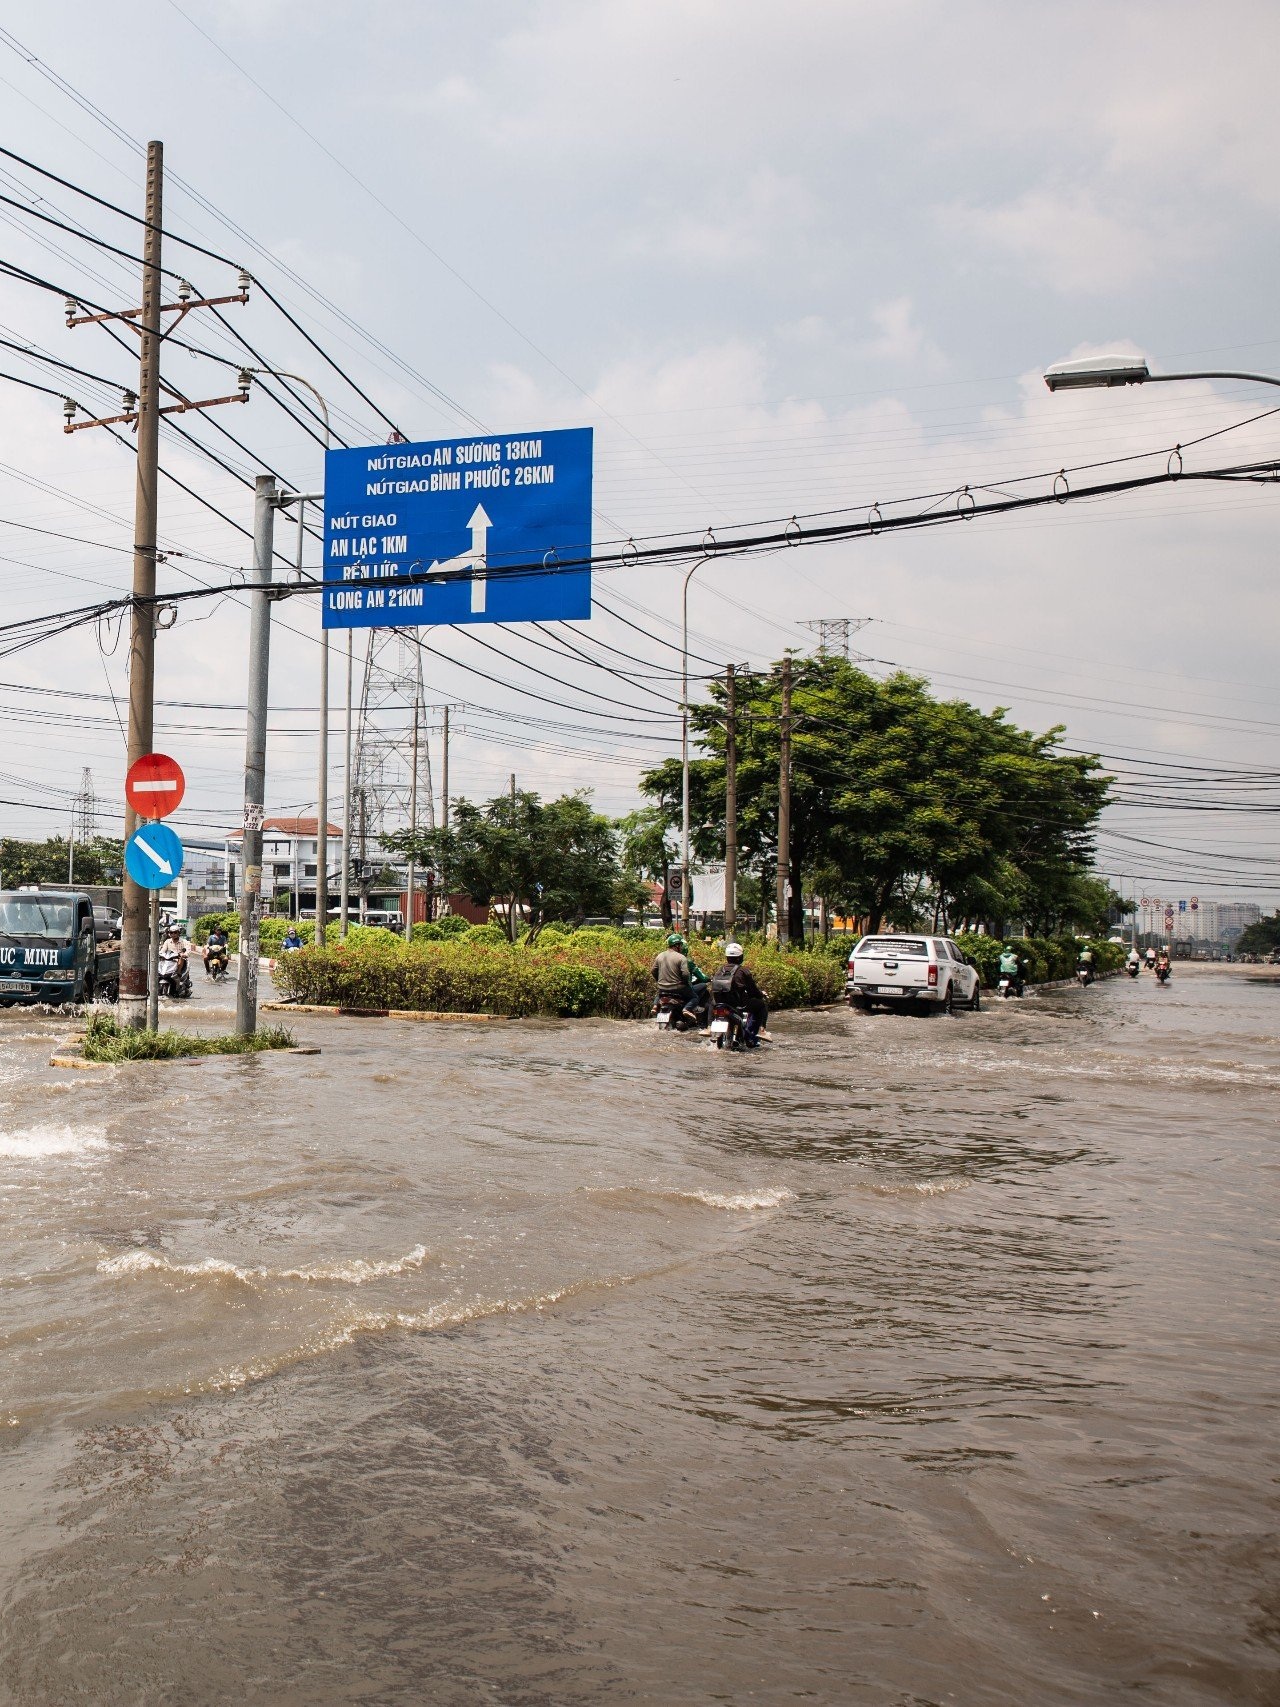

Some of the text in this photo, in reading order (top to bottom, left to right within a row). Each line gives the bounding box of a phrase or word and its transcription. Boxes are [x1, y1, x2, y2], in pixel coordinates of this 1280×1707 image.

[432, 447, 452, 466] AN
[455, 441, 501, 465] SƯƠNG
[505, 439, 542, 461] 13KM
[430, 469, 461, 492] BÌNH
[464, 464, 511, 490] PHƯỚC
[514, 465, 554, 486] 26KM
[330, 511, 397, 530] NÚT GIAO
[330, 535, 408, 559] AN LẠC 1KM
[329, 588, 424, 610] LONG AN 21KM
[23, 948, 59, 966] MINH
